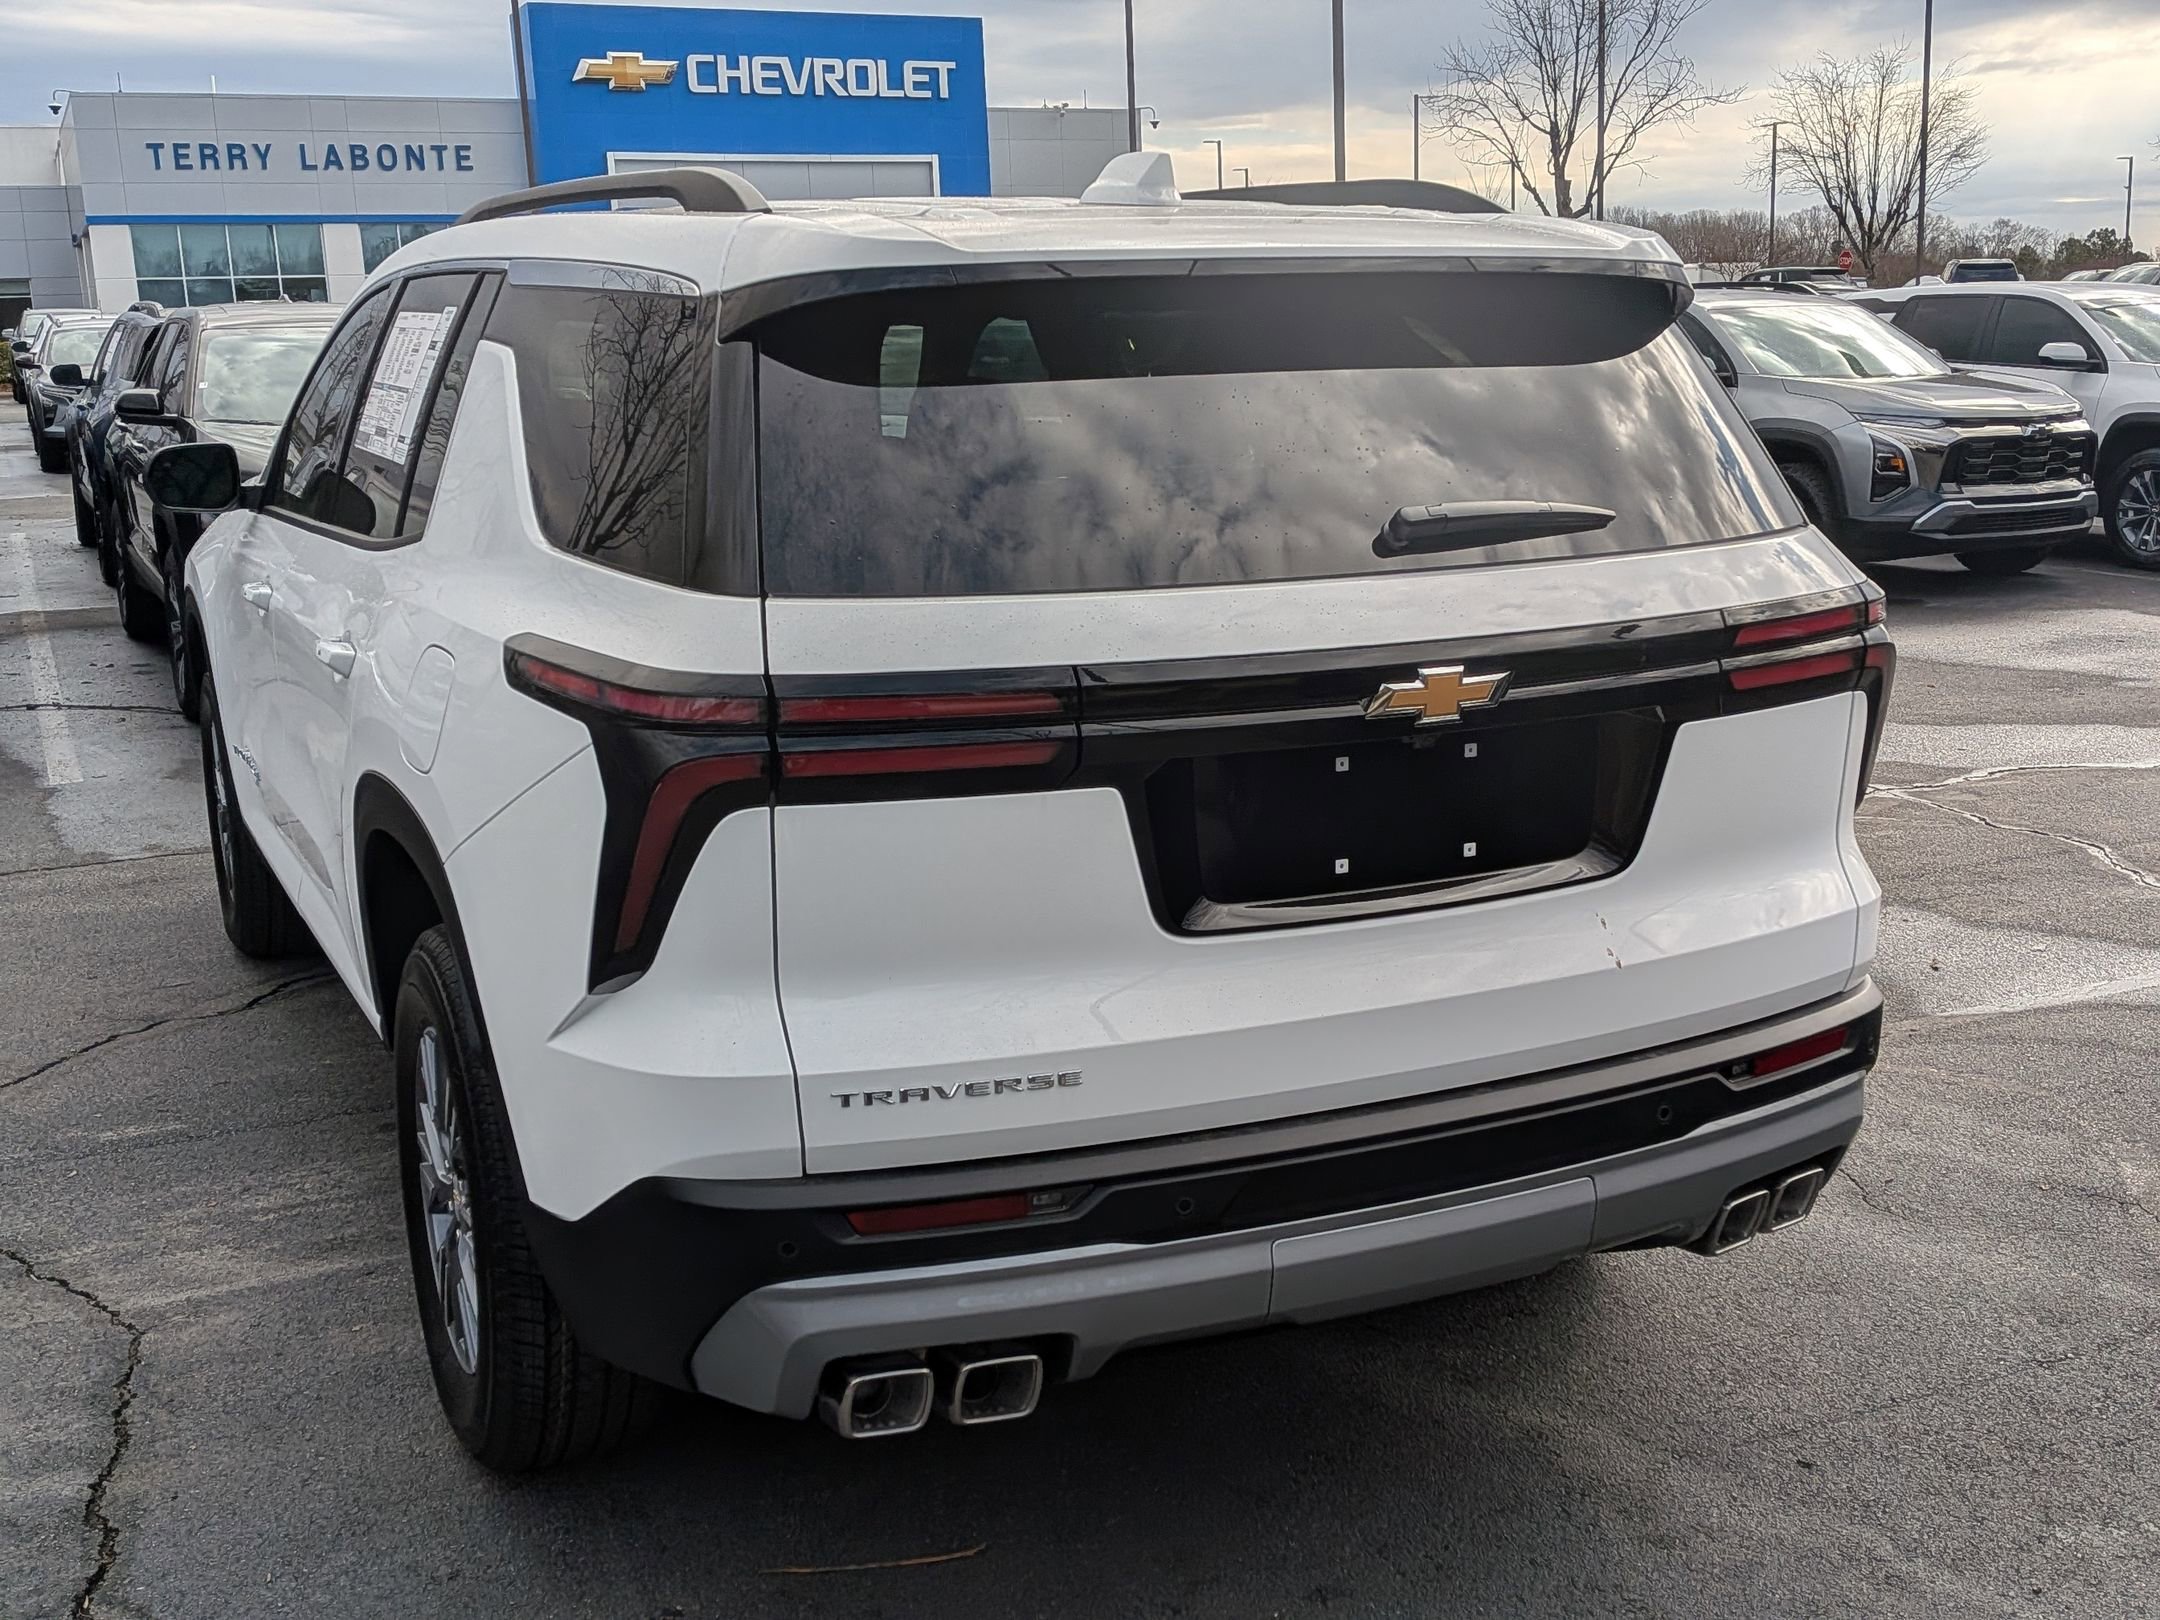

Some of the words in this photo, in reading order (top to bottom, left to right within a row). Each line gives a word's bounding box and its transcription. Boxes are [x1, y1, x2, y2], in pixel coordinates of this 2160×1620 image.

[687, 54, 956, 98] CHEVROLET
[146, 142, 272, 171] TERRY
[299, 143, 474, 171] LABONTE
[1840, 256, 1853, 265] STOP
[831, 1069, 1083, 1108] TRAVERSE
